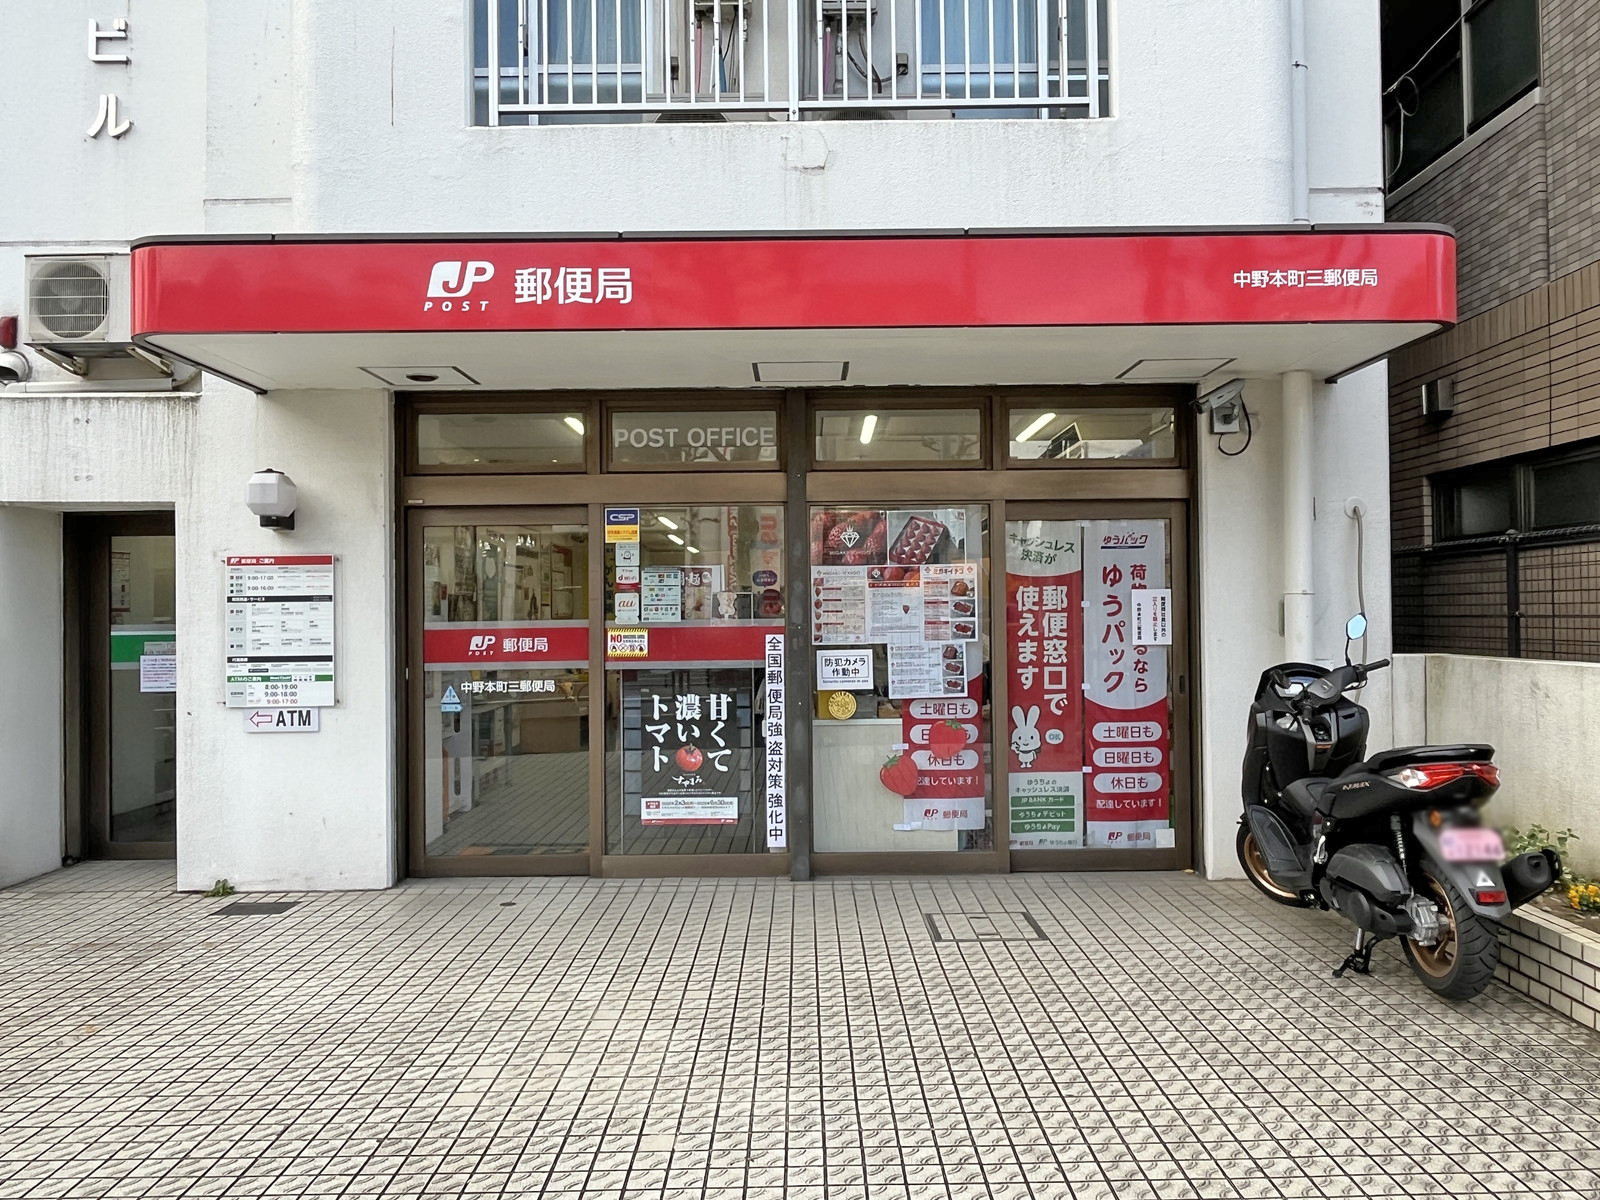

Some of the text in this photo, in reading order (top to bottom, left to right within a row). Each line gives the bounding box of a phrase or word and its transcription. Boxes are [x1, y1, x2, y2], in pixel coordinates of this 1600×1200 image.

[86, 18, 132, 139] ビル
[1233, 268, 1379, 289] 中野本町三郵便局
[514, 267, 633, 305] 郵便局
[424, 300, 489, 312] POST
[614, 426, 775, 449] POST OFFICE
[610, 514, 635, 522] CSP
[1008, 532, 1075, 554] キャッシュレス
[1102, 532, 1148, 546] ゆうパック
[1020, 548, 1058, 565] 決済が
[618, 600, 636, 608] au
[1102, 564, 1126, 692] ゆうパック
[610, 634, 622, 643] NO
[1016, 586, 1040, 690] 使えます
[502, 638, 549, 653] 郵便局
[1042, 586, 1068, 716] 郵便窓口で
[824, 658, 866, 668] 防犯カメラ
[832, 668, 860, 676] 作動中
[460, 680, 556, 694] 中野本町三郵便局
[920, 702, 970, 716] 土曜日も
[276, 710, 312, 727] ATM
[674, 694, 701, 743] 濃い
[645, 694, 671, 772] トマト
[706, 693, 732, 772] 甘くて
[766, 636, 784, 842] 全国郵便局強盗対策強化中
[1102, 726, 1154, 739] 土曜日も
[928, 754, 964, 766] 休日も
[1104, 751, 1154, 764] 日曜日も
[1111, 776, 1148, 789] 休日も
[1016, 786, 1070, 794] キャッシュレス決済
[942, 810, 968, 819] 郵便局
[1024, 823, 1060, 831] ゆうちょPay
[1126, 832, 1151, 842] 郵便局
